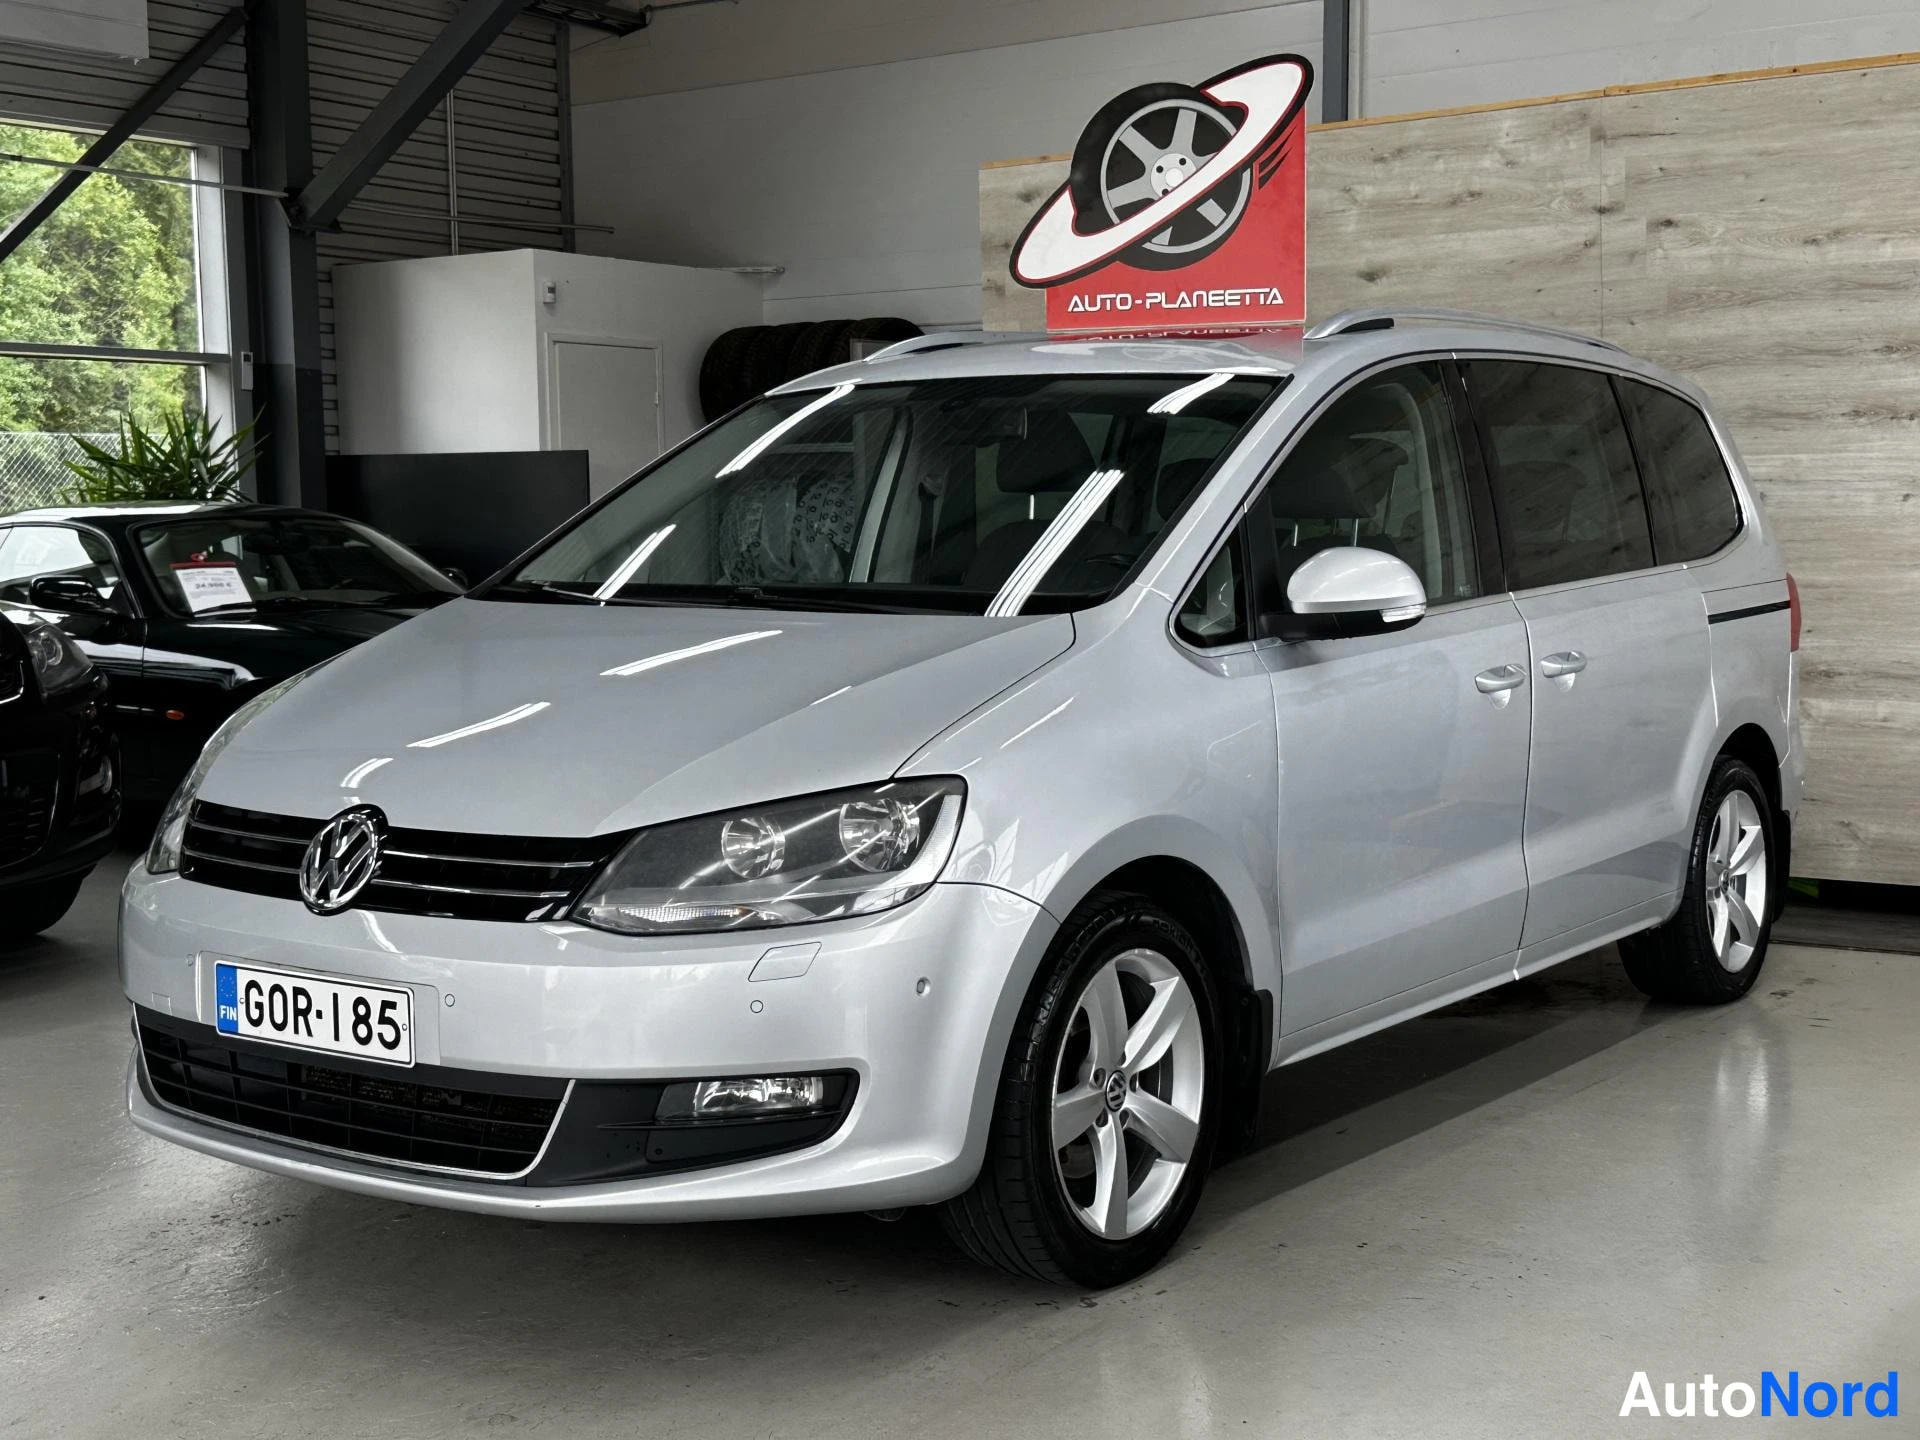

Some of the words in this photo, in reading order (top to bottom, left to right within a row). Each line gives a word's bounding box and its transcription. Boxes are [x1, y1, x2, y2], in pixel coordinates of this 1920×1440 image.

[1068, 288, 1284, 312] AUTO-PLANEETTA
[220, 1005, 237, 1021] FIN
[244, 979, 401, 1050] GOR-185
